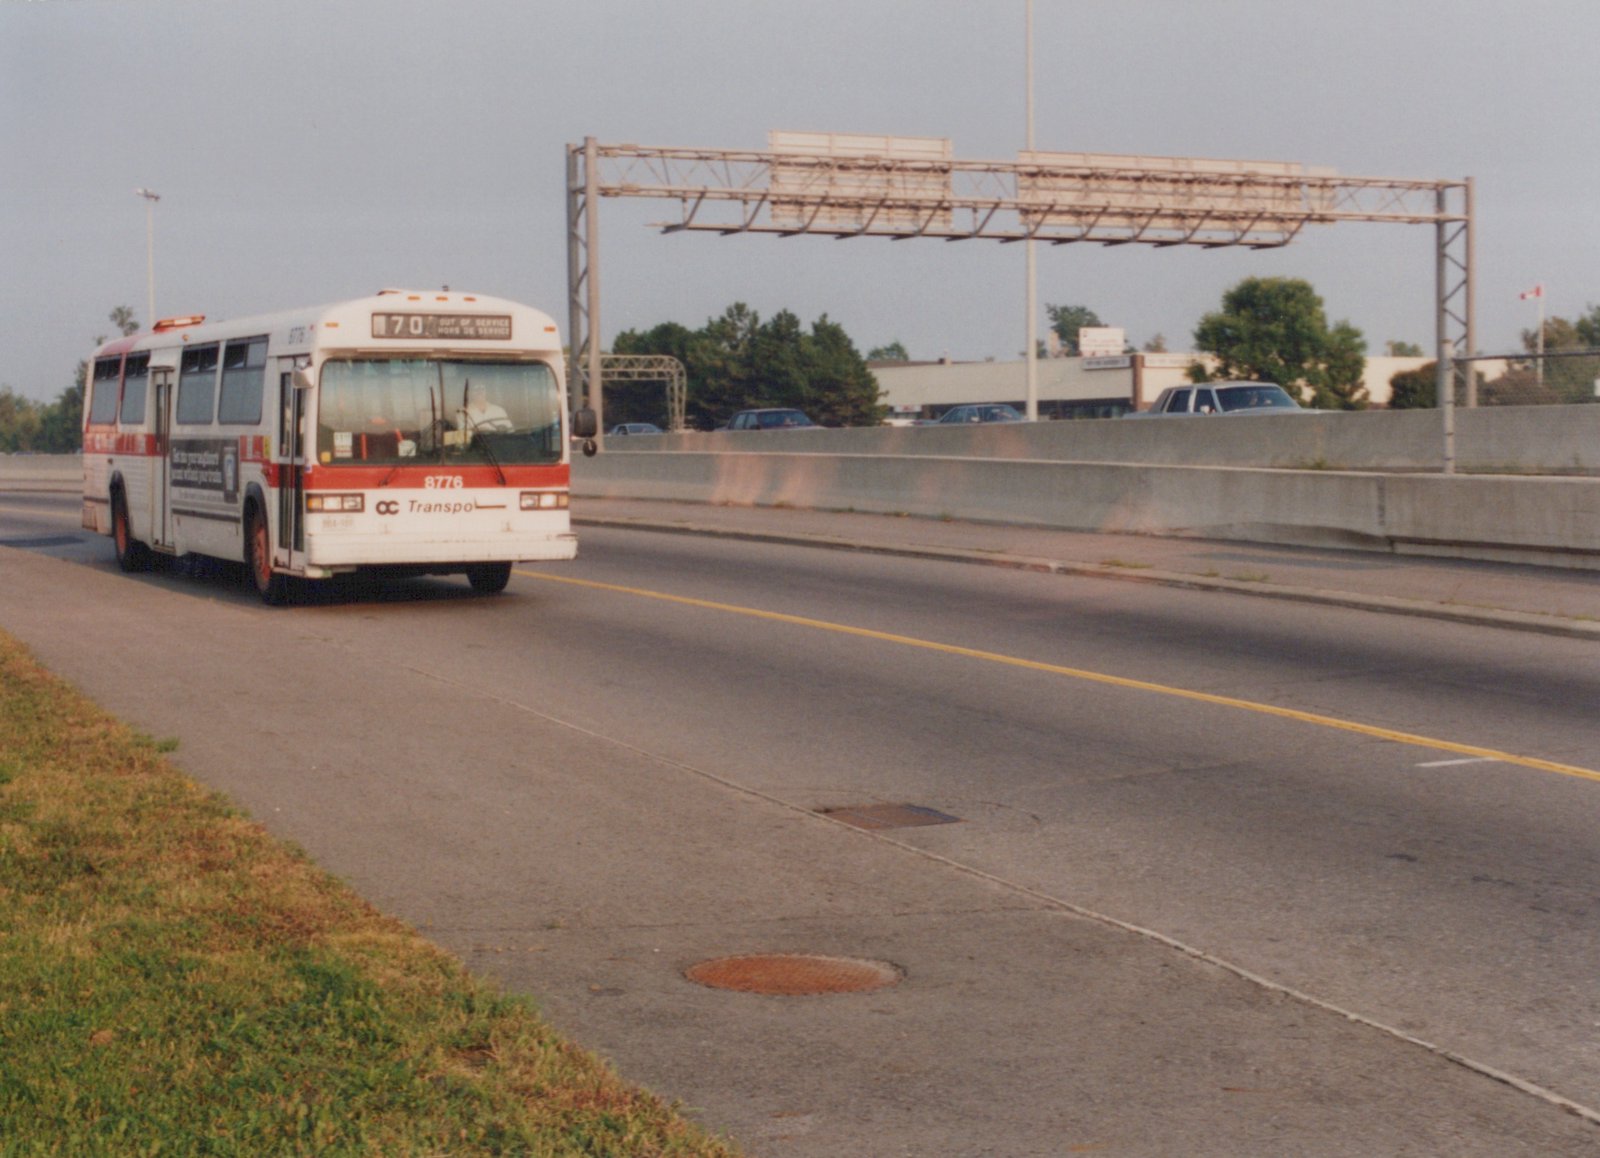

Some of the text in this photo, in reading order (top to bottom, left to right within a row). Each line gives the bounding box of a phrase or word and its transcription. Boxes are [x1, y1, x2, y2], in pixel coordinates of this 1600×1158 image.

[390, 315, 424, 335] 70
[424, 475, 463, 489] 8776
[375, 500, 473, 515] OC Transpo
